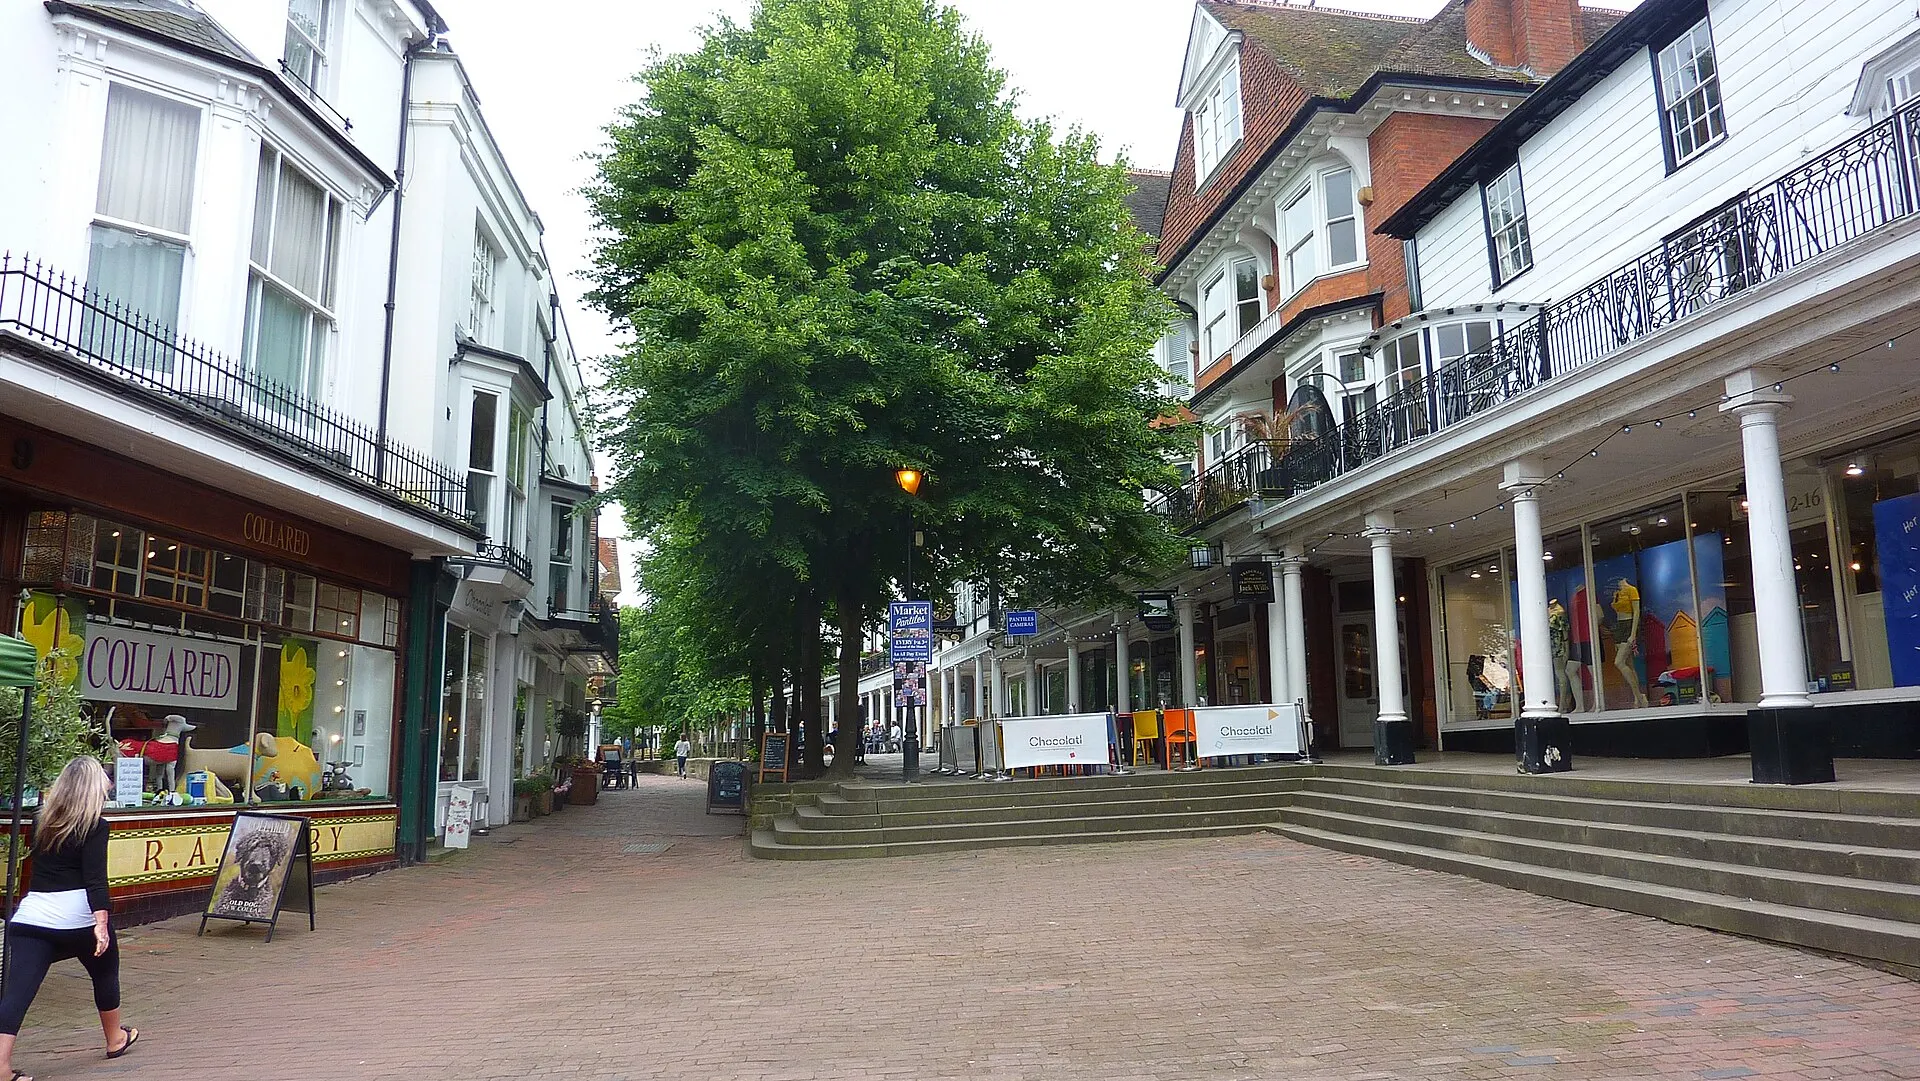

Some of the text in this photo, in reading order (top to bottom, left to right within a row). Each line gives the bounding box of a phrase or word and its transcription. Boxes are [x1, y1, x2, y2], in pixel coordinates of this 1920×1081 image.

[1467, 370, 1493, 389] ERECTED
[1786, 487, 1821, 513] 2-16
[243, 512, 310, 556] COLLARED
[1238, 584, 1253, 594] Jack
[893, 606, 928, 615] Market
[896, 615, 926, 627] Pantiles
[86, 636, 232, 699] COLLARED
